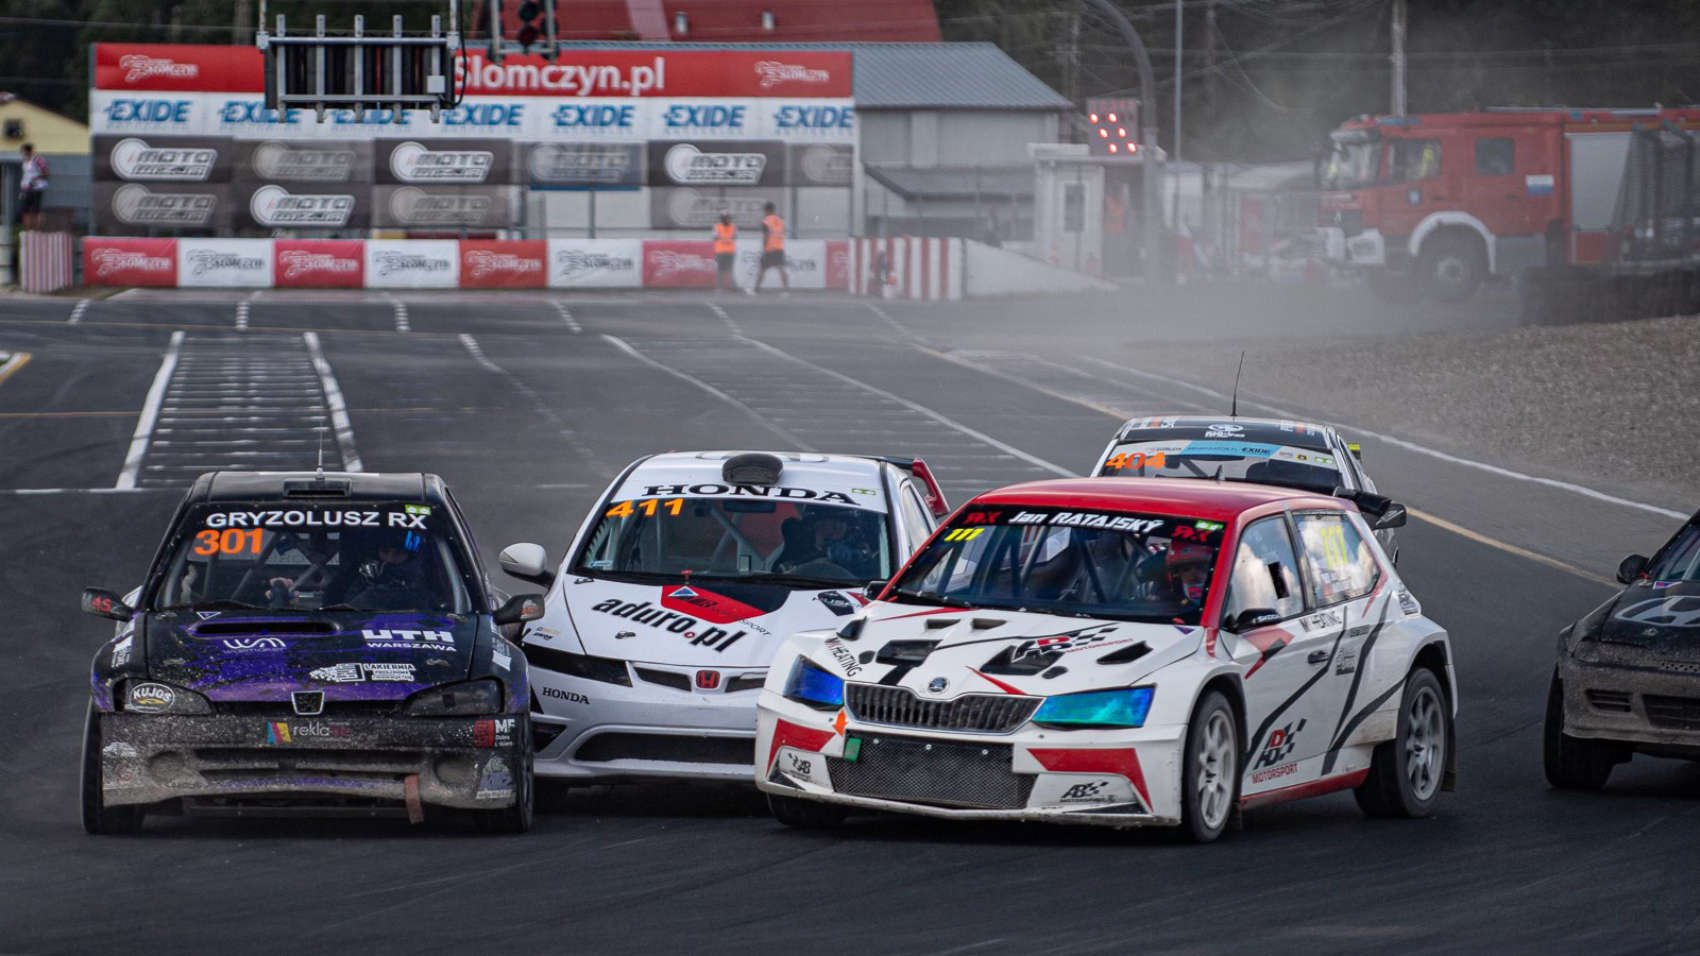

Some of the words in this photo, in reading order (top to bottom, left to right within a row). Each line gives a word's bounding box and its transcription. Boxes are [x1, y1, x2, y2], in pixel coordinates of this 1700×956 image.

[104, 101, 191, 122] EXIDE
[443, 104, 525, 125] EXIDE
[552, 105, 635, 126] EXIDE
[663, 105, 746, 126] EXIDE
[774, 105, 854, 127] EXIDE
[138, 151, 211, 163] MOTO
[415, 154, 488, 166] MOTO
[690, 156, 763, 168] MOTO
[276, 197, 349, 210] MOTO
[1242, 446, 1271, 454] EXIDE
[1105, 452, 1166, 469] 404
[642, 484, 861, 506] HONDA
[606, 498, 684, 518] 411
[206, 511, 380, 528] GRYZOLUSZ
[388, 512, 427, 530] RX
[1008, 511, 1048, 524] Jan
[195, 528, 263, 555] 301
[943, 528, 985, 542] 111
[591, 598, 748, 652] aduro.pl
[361, 629, 455, 643] UTH
[367, 642, 457, 652] WARSZAWA
[133, 686, 172, 702] KUJOS
[542, 686, 591, 704] HONDA
[1252, 763, 1298, 784] MOTORSPORT
